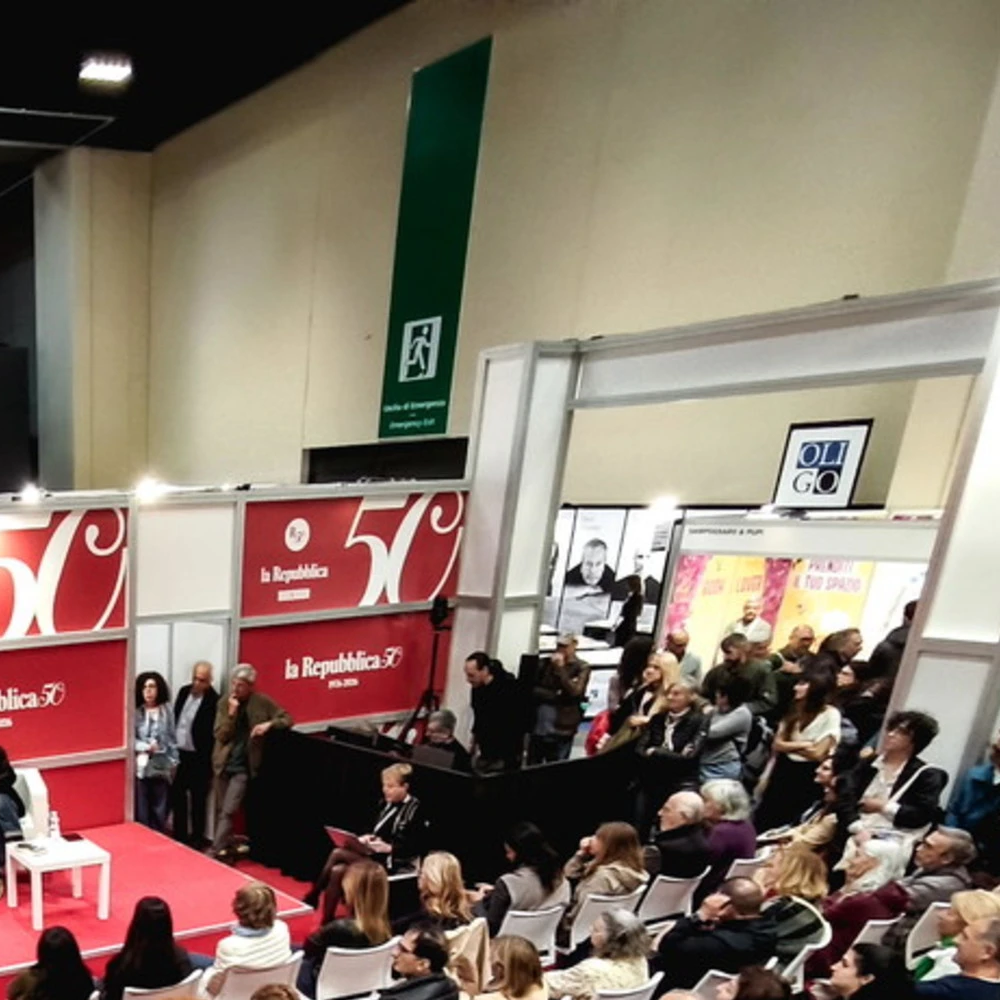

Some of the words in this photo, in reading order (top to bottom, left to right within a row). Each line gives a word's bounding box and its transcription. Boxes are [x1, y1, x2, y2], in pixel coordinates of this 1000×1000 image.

[800, 442, 847, 467] OLI
[792, 470, 840, 495] GO
[261, 567, 271, 583] la
[272, 564, 329, 584] Repubblica
[285, 658, 299, 680] la
[302, 650, 381, 680] Repubblica
